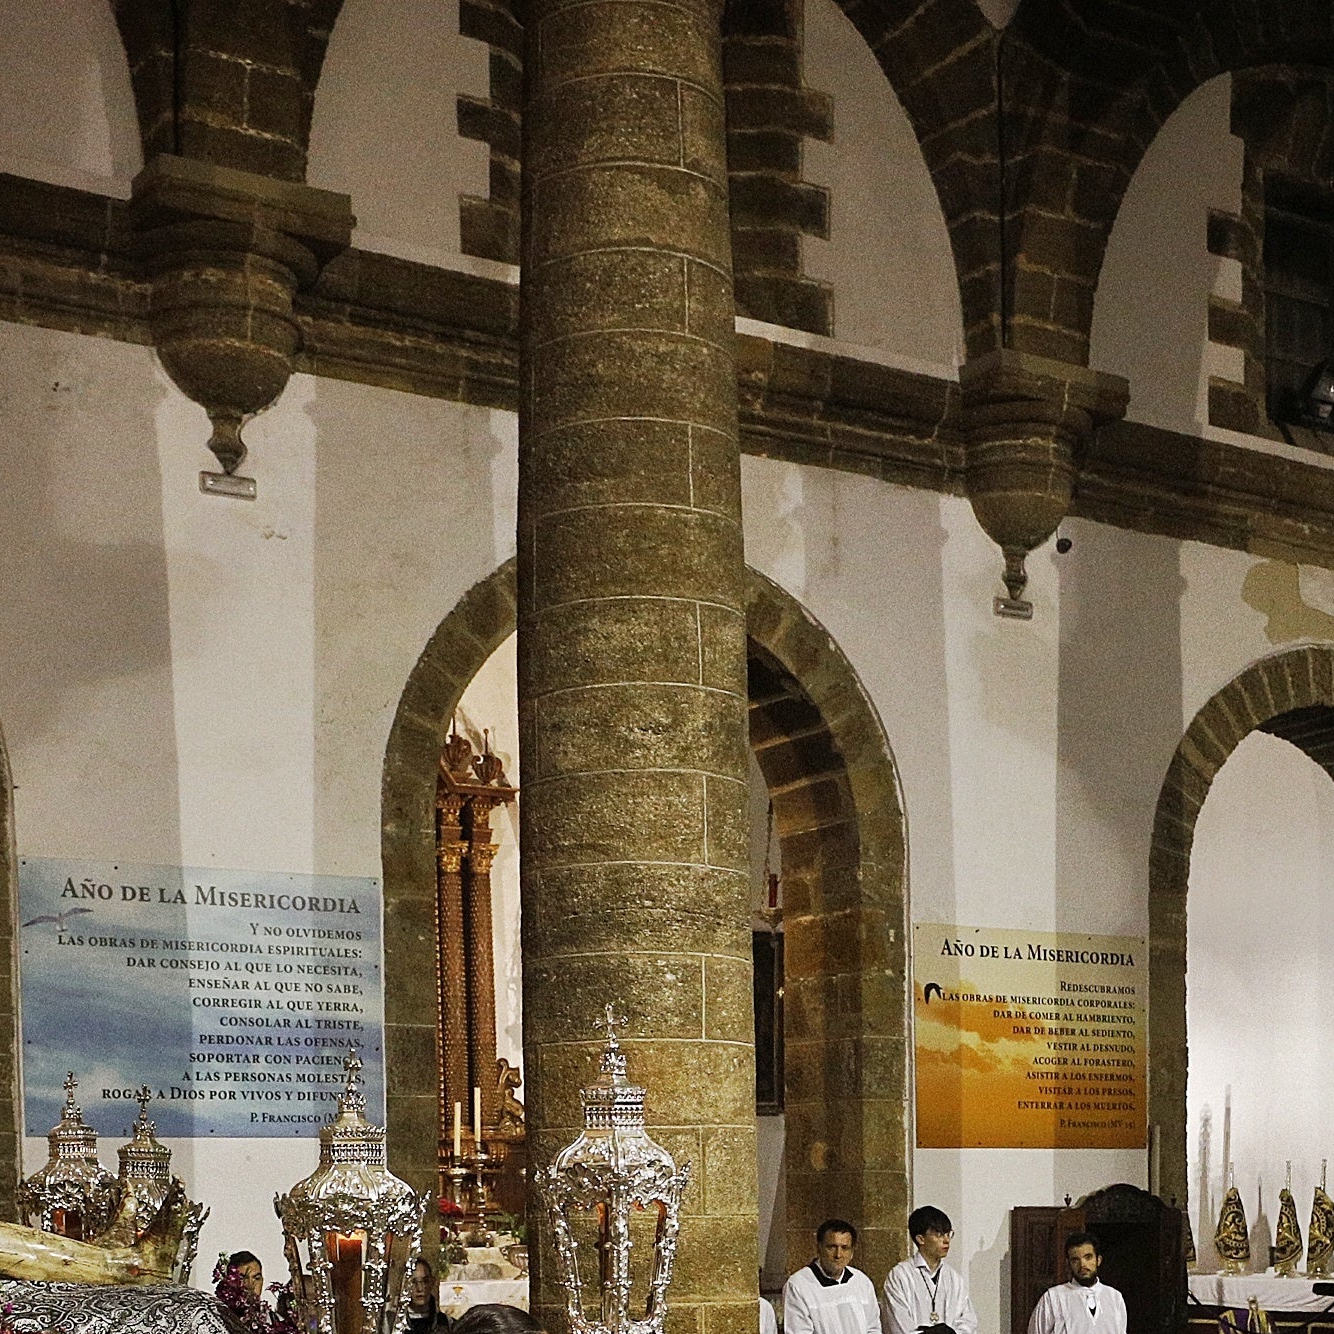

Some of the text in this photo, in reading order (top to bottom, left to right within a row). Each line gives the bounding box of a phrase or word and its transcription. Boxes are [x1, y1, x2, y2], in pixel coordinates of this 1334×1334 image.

[61, 877, 361, 913] AÑO DE LA MISERICORDIA
[250, 923, 362, 940] Y NO OLVIDEMOS
[58, 935, 362, 958] LAS OBRAS DE MISERICORDIA ESPIRITUALES:
[941, 938, 1135, 966] AÑO DE LA MISERICORDIA
[127, 957, 362, 978] DAR CONSEJO AL QUE LO NECESITA,
[189, 977, 363, 995] ENSEÑAR AL QUE NO SABE,
[1060, 981, 1135, 994] REDESCUBRAMOS
[193, 997, 363, 1013] CORREGIR AL QUE YERRA,
[942, 993, 1135, 1009] LAS OBRAS DE MISERICORDIA CORPORALES:
[220, 1016, 364, 1031] CONSOLAR AL TRISTE,
[994, 1010, 1135, 1025] DAR DE COMER AL HAMBRIENTO,
[1013, 1026, 1031, 1034] DAR
[1035, 1027, 1045, 1035] DE
[1048, 1028, 1076, 1036] BEBER
[1092, 1030, 1135, 1039] SEDIENTO,
[199, 1035, 364, 1049] PERDONAR LAS OFENSAS,
[1047, 1042, 1077, 1051] VESTIR
[1093, 1044, 1135, 1054] DESNUDO,
[189, 1053, 260, 1064] SOPORTAR
[265, 1055, 291, 1064] CON
[1033, 1057, 1135, 1068] ACOGER AL FORASTERO,
[183, 1072, 191, 1081] A
[196, 1072, 220, 1081] LAS
[225, 1073, 292, 1082] PERSONAS
[1026, 1072, 1059, 1080] ASISTIR
[157, 1090, 165, 1099] A
[171, 1087, 205, 1100] DIOS
[210, 1090, 236, 1100] POR
[241, 1091, 281, 1100] VIVOS
[286, 1092, 293, 1100] Y
[1039, 1086, 1074, 1095] VISITAR
[1018, 1101, 1064, 1109] ENTERRAR
[251, 1113, 259, 1122] P.
[263, 1113, 320, 1123] FRANCISCO
